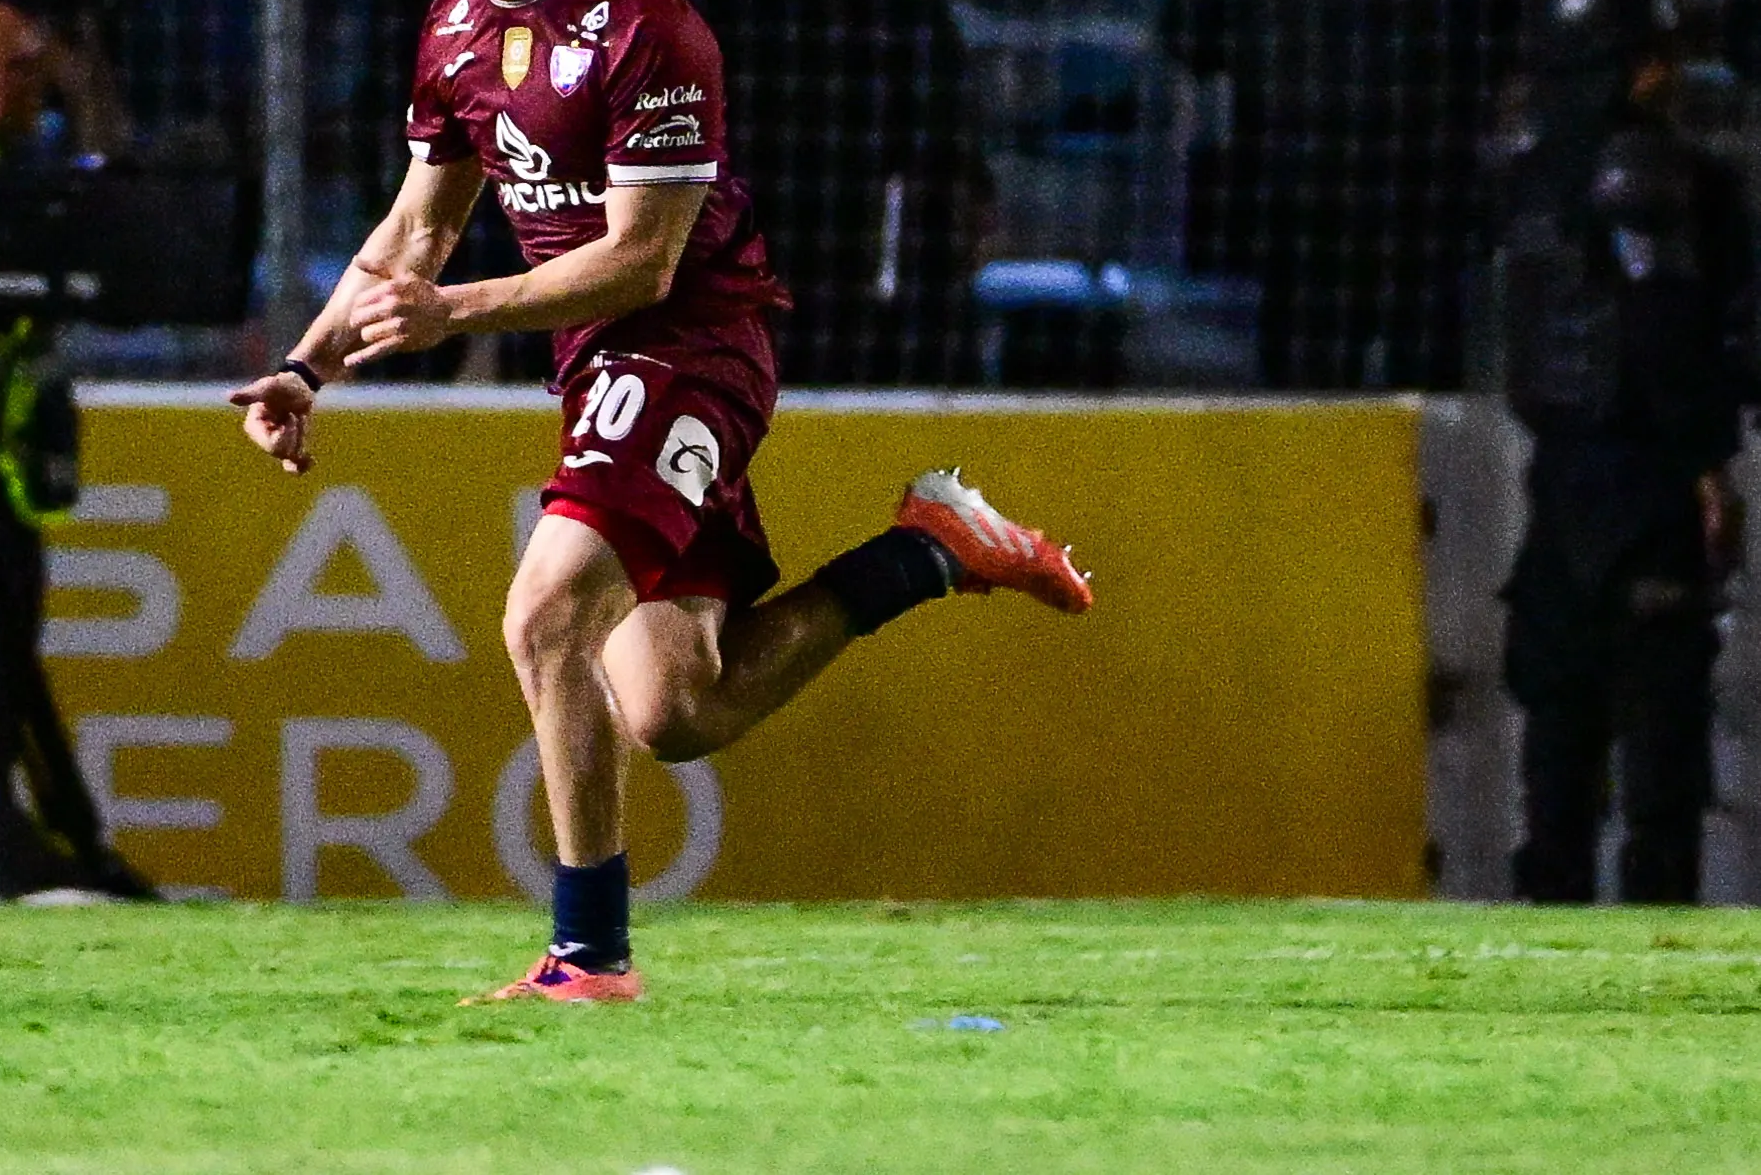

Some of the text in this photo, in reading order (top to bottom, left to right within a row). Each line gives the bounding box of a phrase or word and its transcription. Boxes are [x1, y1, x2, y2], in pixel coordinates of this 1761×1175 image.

[634, 83, 704, 111] Red Cola
[626, 131, 703, 149] Electrolit
